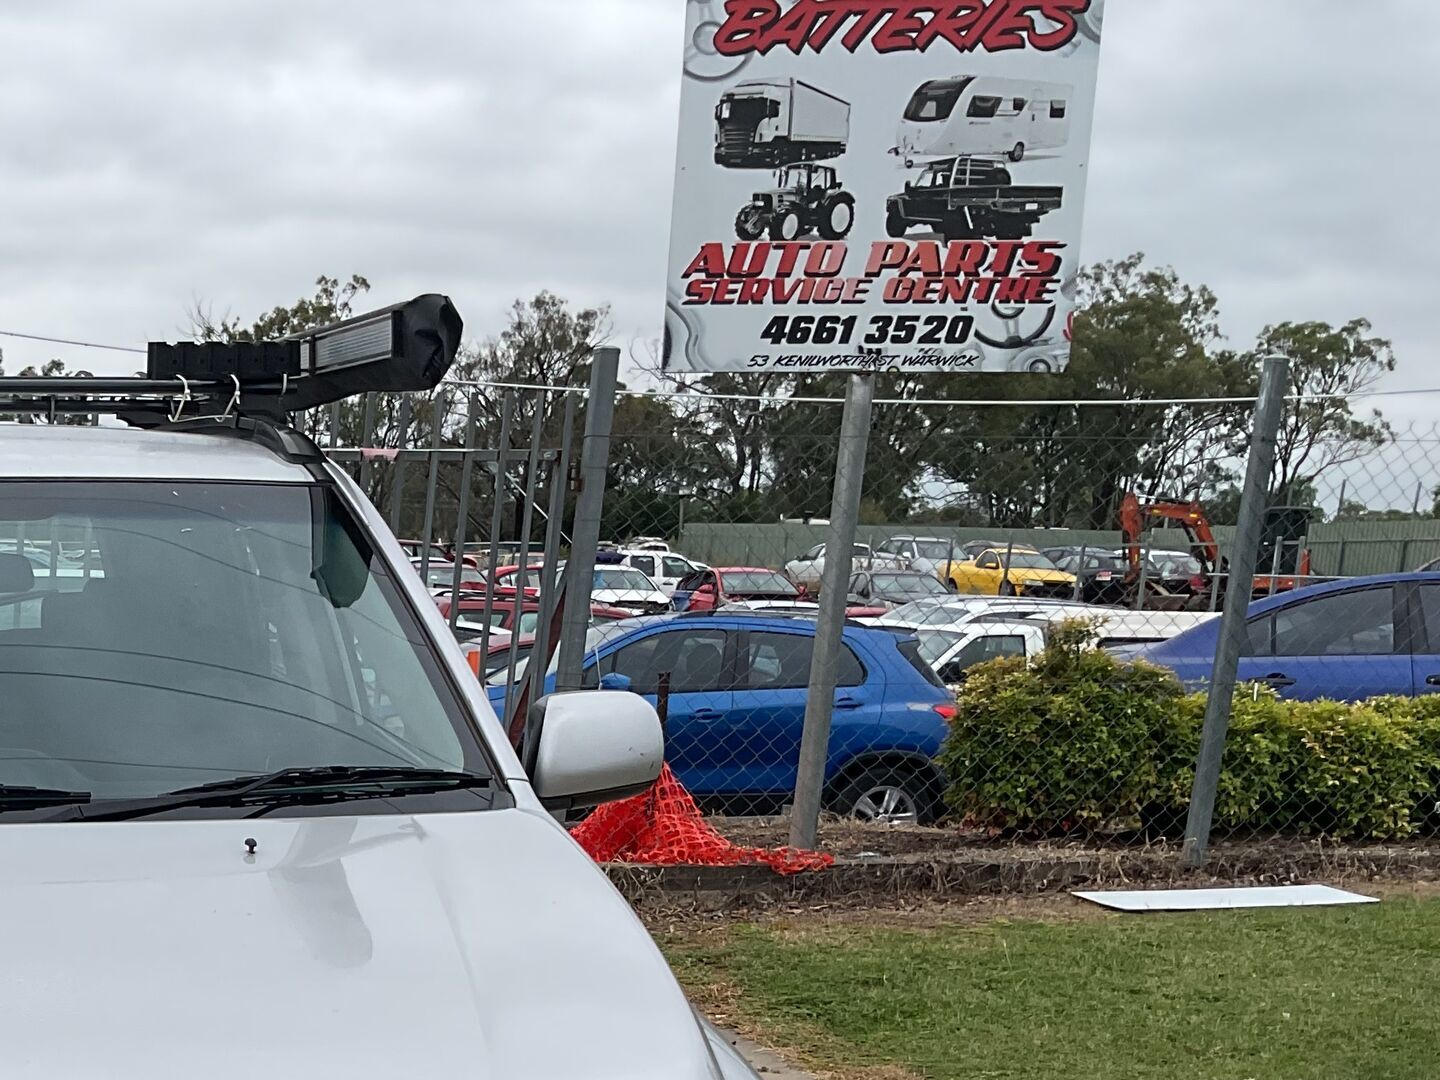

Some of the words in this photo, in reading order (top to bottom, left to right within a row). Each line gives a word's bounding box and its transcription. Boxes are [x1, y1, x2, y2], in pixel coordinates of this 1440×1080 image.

[713, 0, 1091, 56] BATTERIES
[681, 241, 848, 279] AUTO
[864, 241, 1067, 277] PARTS
[681, 278, 873, 305] SERVICE
[883, 277, 1061, 304] CENTRE
[760, 315, 858, 344] 4661
[863, 315, 974, 344] 3520
[747, 355, 769, 367] 53
[773, 354, 872, 367] KENILWORTH
[876, 354, 900, 366] ST
[901, 354, 980, 367] WARWICK
